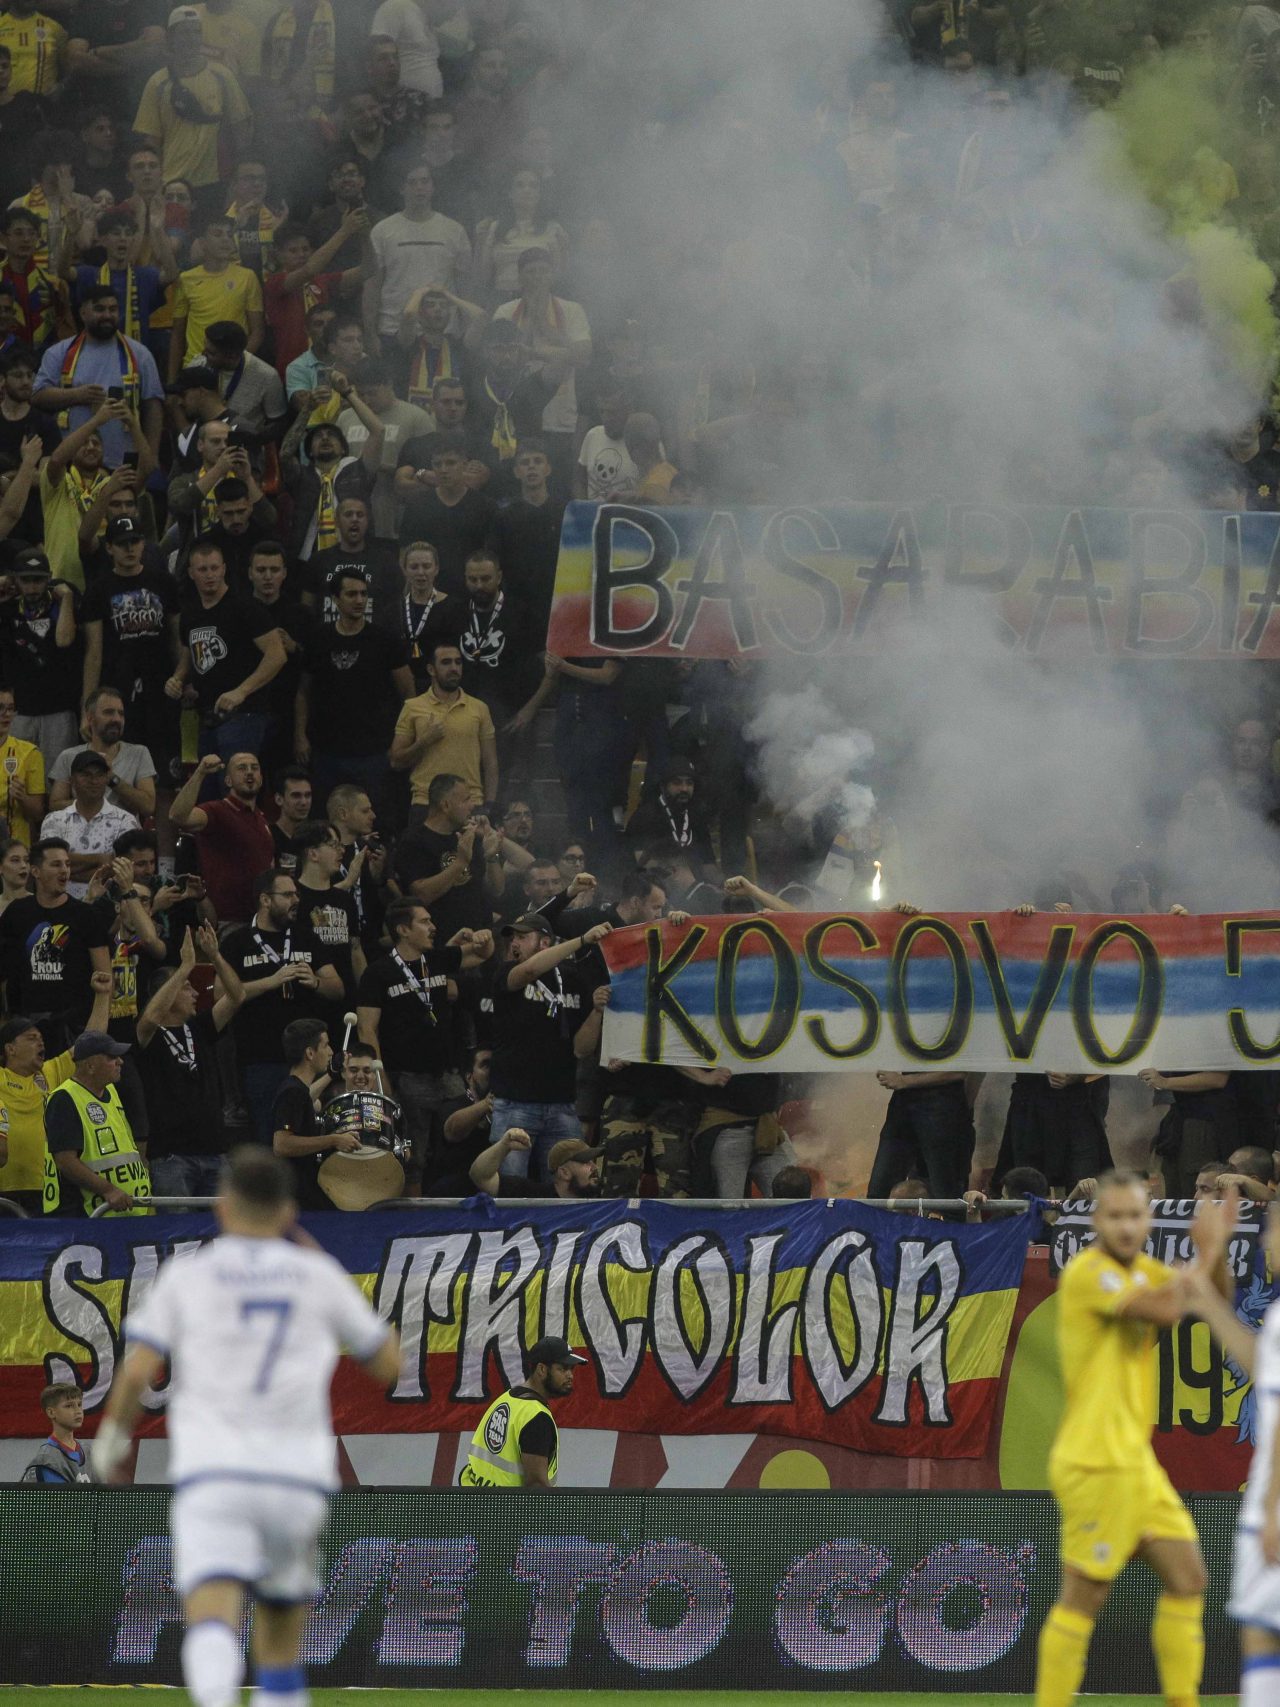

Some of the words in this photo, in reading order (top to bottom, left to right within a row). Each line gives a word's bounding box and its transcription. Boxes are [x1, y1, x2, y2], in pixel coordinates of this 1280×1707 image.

[645, 920, 1165, 1067] KOSOVO
[241, 1300, 291, 1395] 7
[375, 1221, 956, 1427] TRICOLOR
[512, 1535, 736, 1670] TO
